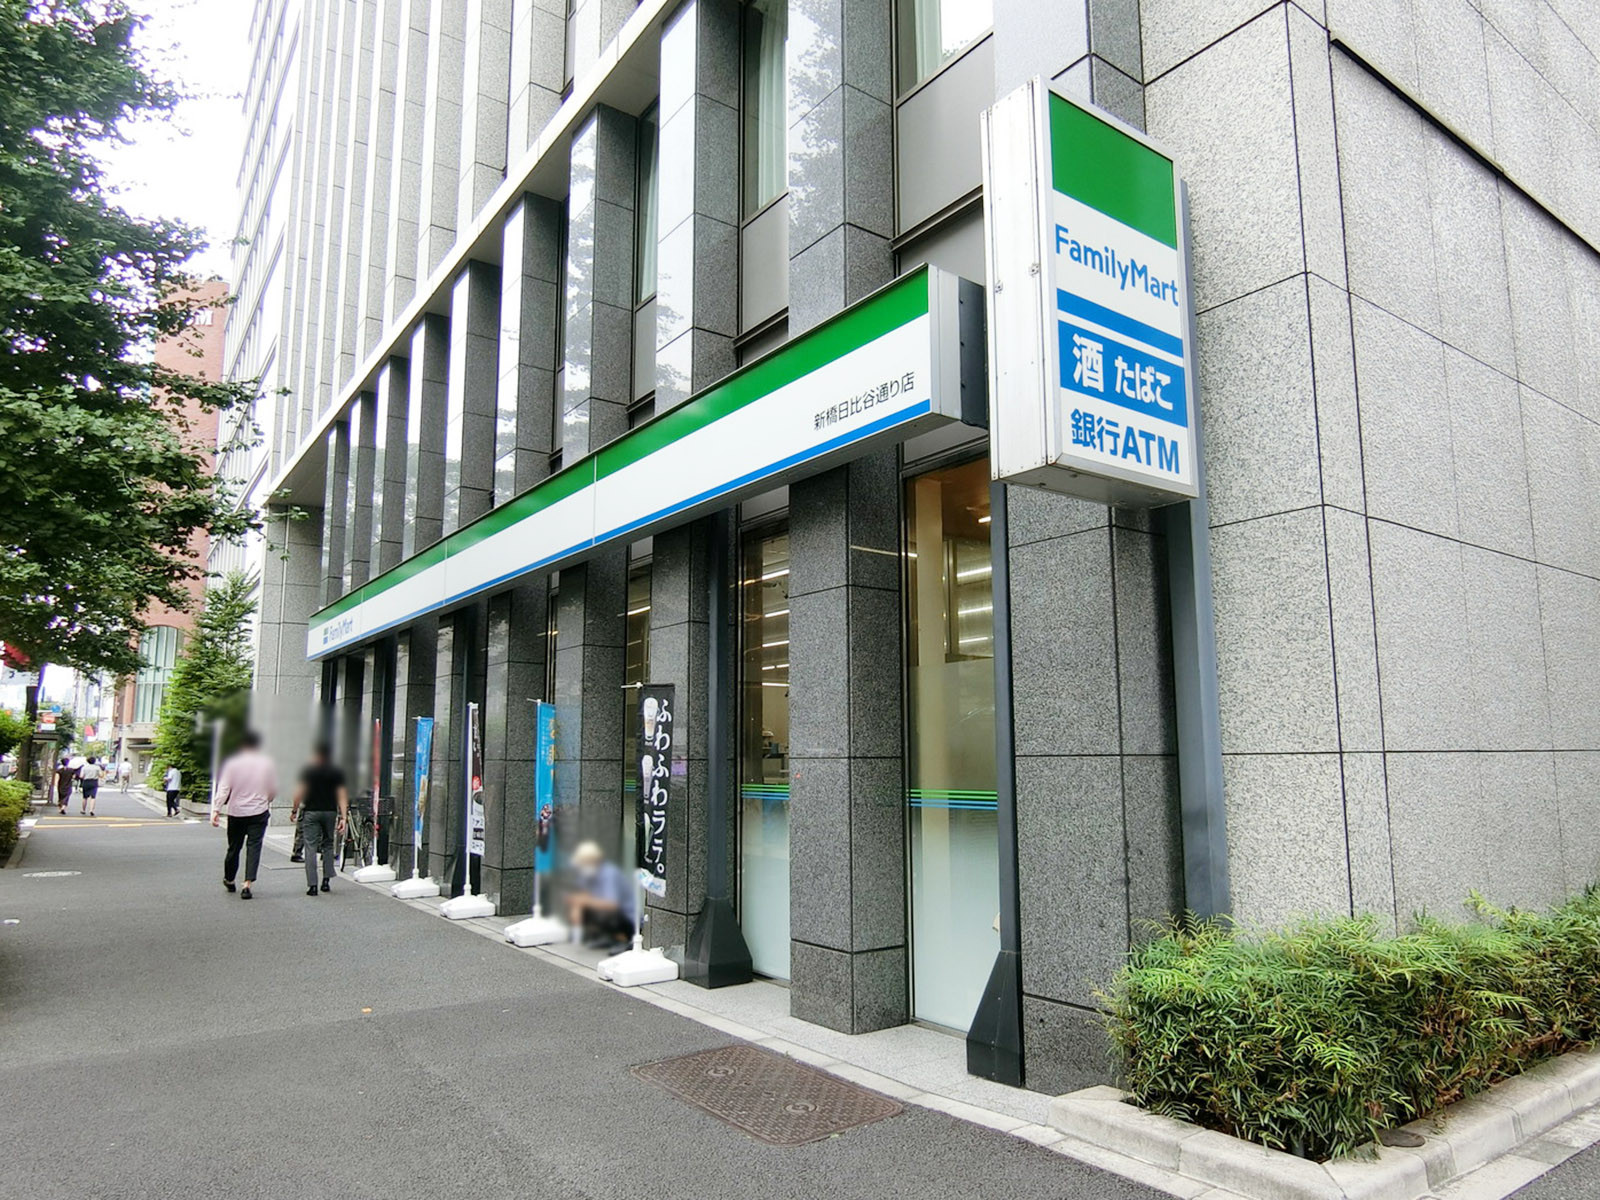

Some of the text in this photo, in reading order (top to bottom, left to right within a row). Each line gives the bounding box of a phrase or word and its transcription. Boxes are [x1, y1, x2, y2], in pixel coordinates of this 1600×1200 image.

[1054, 223, 1179, 307] FamilyMart
[813, 371, 915, 431] 新橋日比谷通り店
[1072, 332, 1174, 411] 酒 たばこ
[1070, 408, 1180, 475] 銀行ATM
